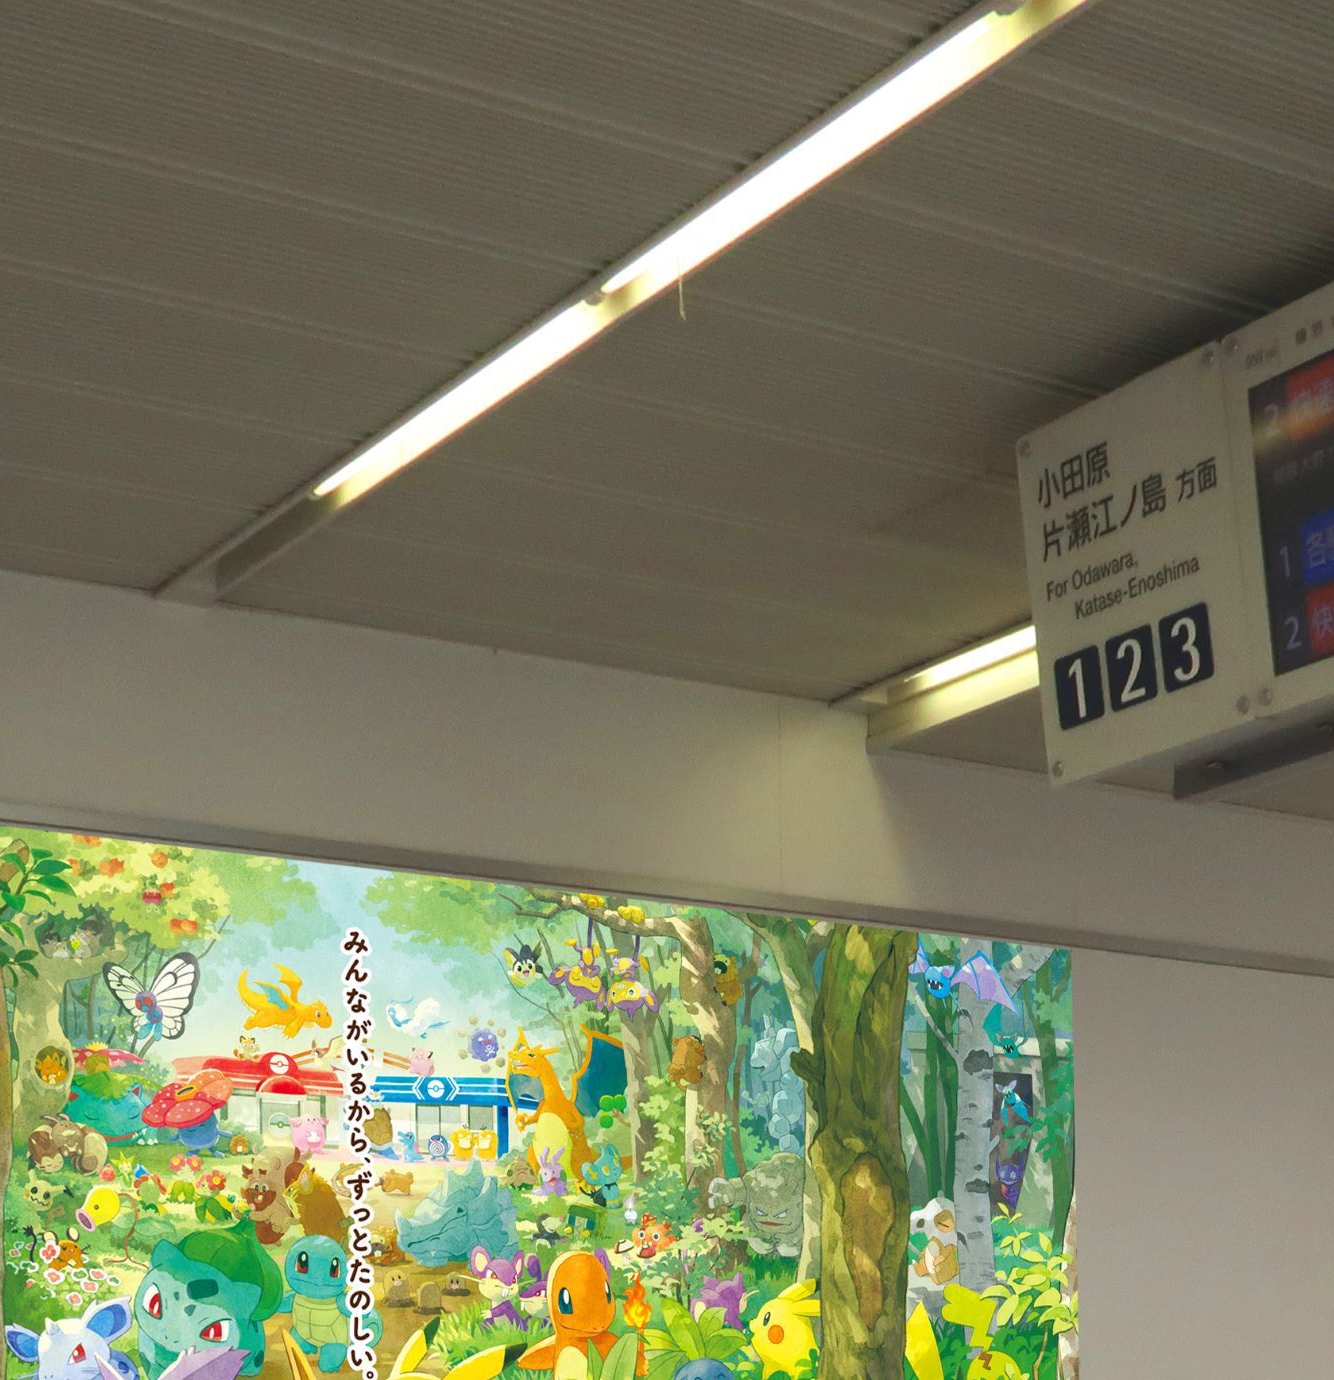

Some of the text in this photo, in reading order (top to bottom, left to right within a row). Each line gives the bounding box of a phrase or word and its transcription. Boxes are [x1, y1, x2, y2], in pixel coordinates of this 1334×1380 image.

[1037, 441, 1111, 509] 小田原
[1042, 456, 1218, 562] 片瀬江ノ島 方面
[1046, 552, 1138, 602] For Odawara,
[1075, 556, 1201, 620] Katase-Enoshima
[1278, 545, 1292, 578] 1
[1284, 616, 1303, 652] 2
[1068, 616, 1201, 719] 1 2 3
